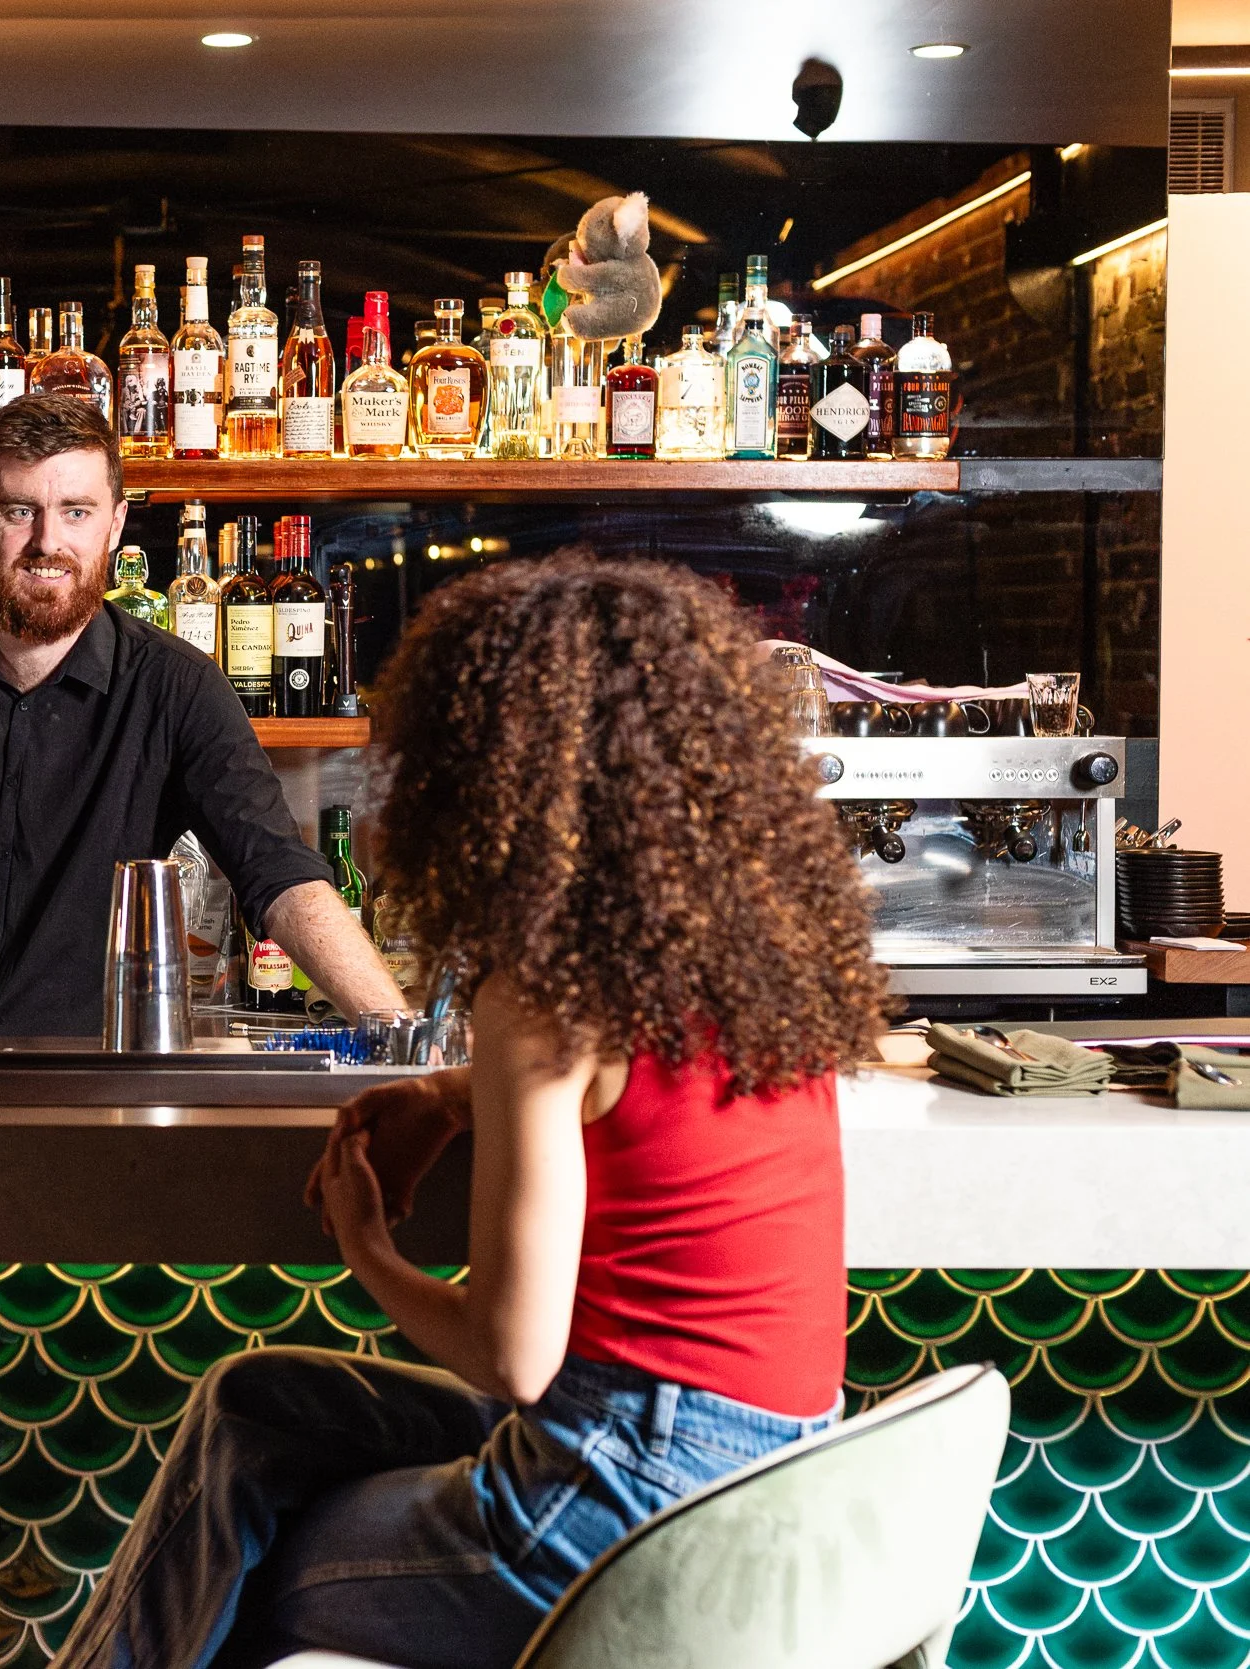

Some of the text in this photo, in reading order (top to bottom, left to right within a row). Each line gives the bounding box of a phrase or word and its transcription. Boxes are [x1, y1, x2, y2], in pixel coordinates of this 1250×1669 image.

[741, 362, 764, 374] BOMBAY
[903, 383, 920, 392] FOUR
[351, 396, 402, 406] Maker's
[365, 407, 401, 417] Mark
[778, 405, 810, 414] LOOD
[258, 941, 282, 952] VERMO
[1089, 976, 1118, 986] EX2
